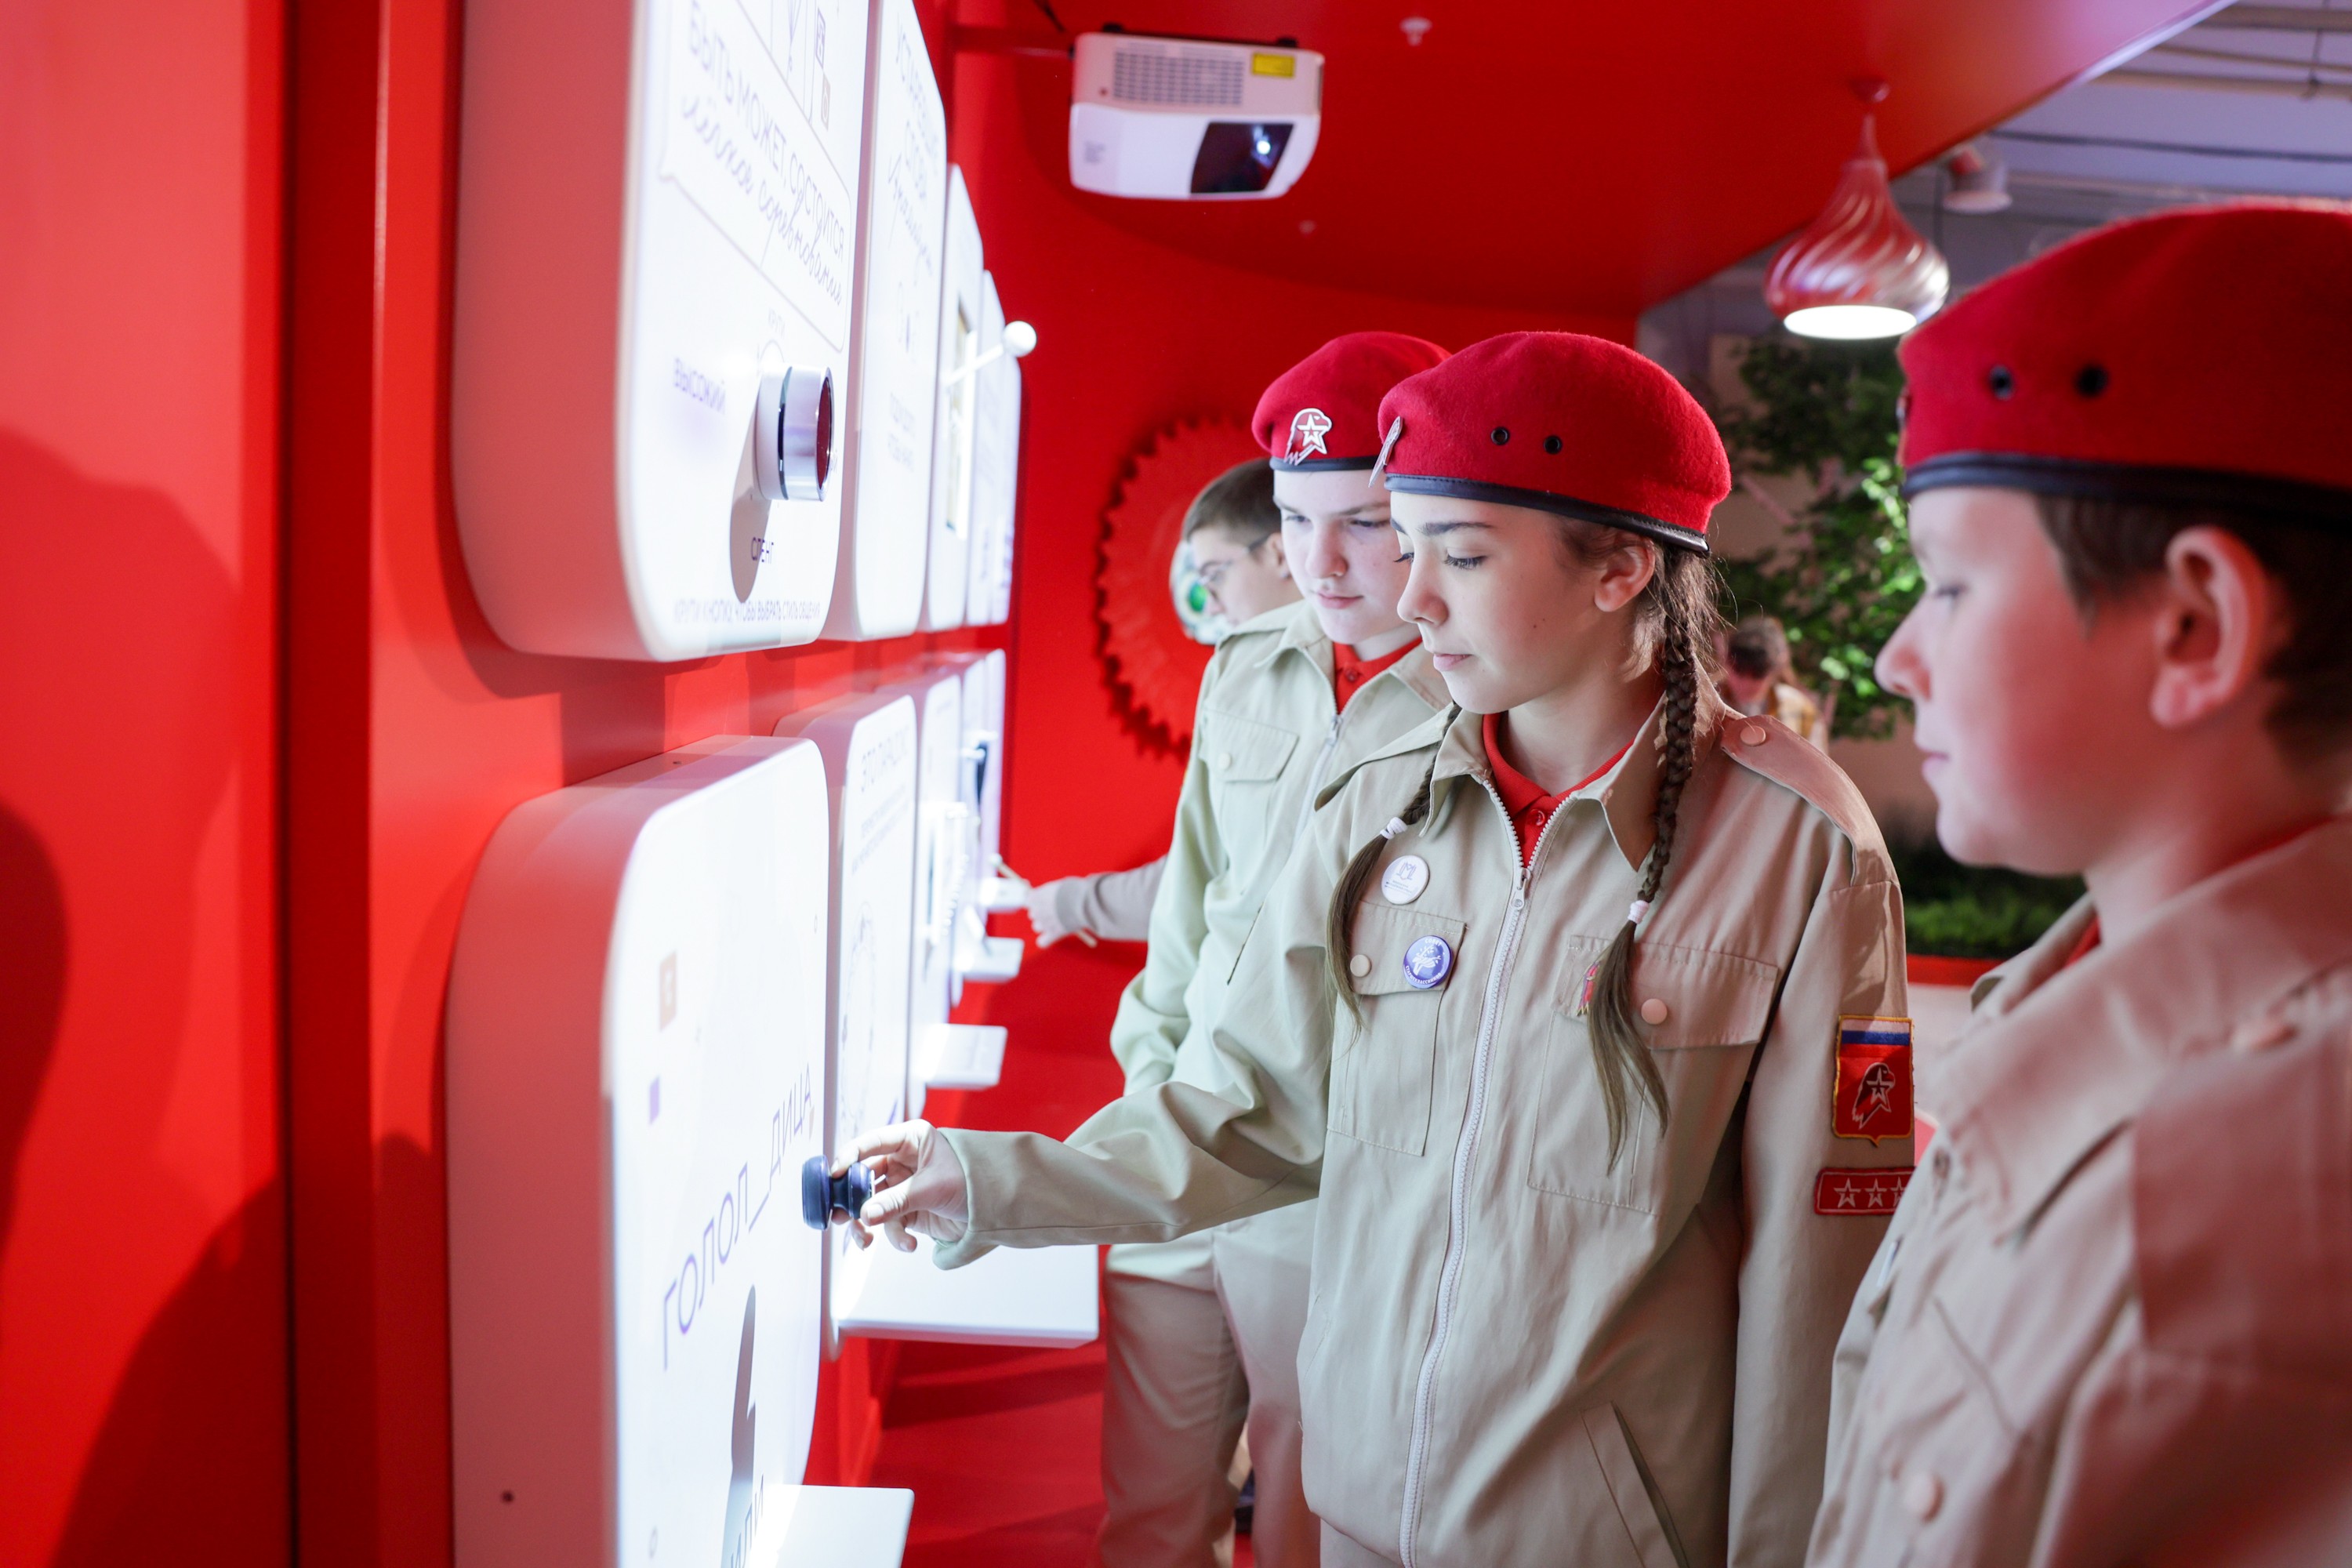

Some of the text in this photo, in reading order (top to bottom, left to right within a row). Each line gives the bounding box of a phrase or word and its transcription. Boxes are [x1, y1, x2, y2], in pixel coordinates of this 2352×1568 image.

[688, 1, 735, 107] БЫТЬ
[789, 151, 845, 264] СОСТОИТСЯ
[673, 355, 728, 416] ВЫСОКИЙ
[750, 536, 775, 564] СЛЕНГ
[757, 599, 782, 622] ВЫБРАТЬ
[782, 600, 798, 621] СТИЛЬ
[798, 601, 821, 623] ОБЩЕНИЯ
[1424, 938, 1443, 946] СОВЕТ
[662, 1062, 812, 1374] ГОЛОЛ_ДИЦА
